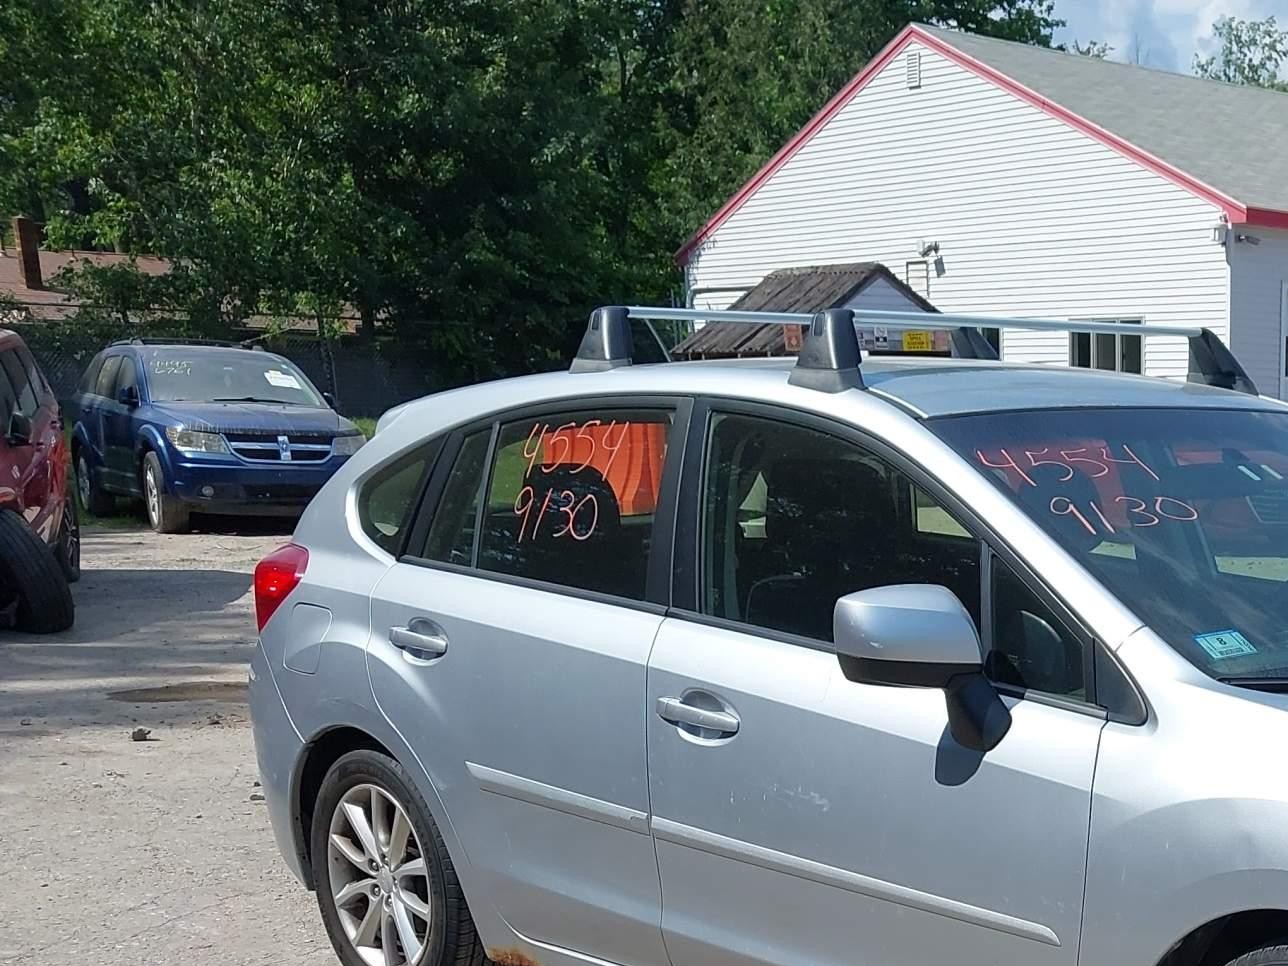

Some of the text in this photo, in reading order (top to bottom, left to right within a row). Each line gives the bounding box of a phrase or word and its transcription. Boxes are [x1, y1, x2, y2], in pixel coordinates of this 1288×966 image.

[523, 419, 630, 481] 4554
[974, 443, 1162, 489] 4554
[513, 485, 599, 544] 9130
[1048, 494, 1199, 536] 9130
[1215, 637, 1228, 646] 8
